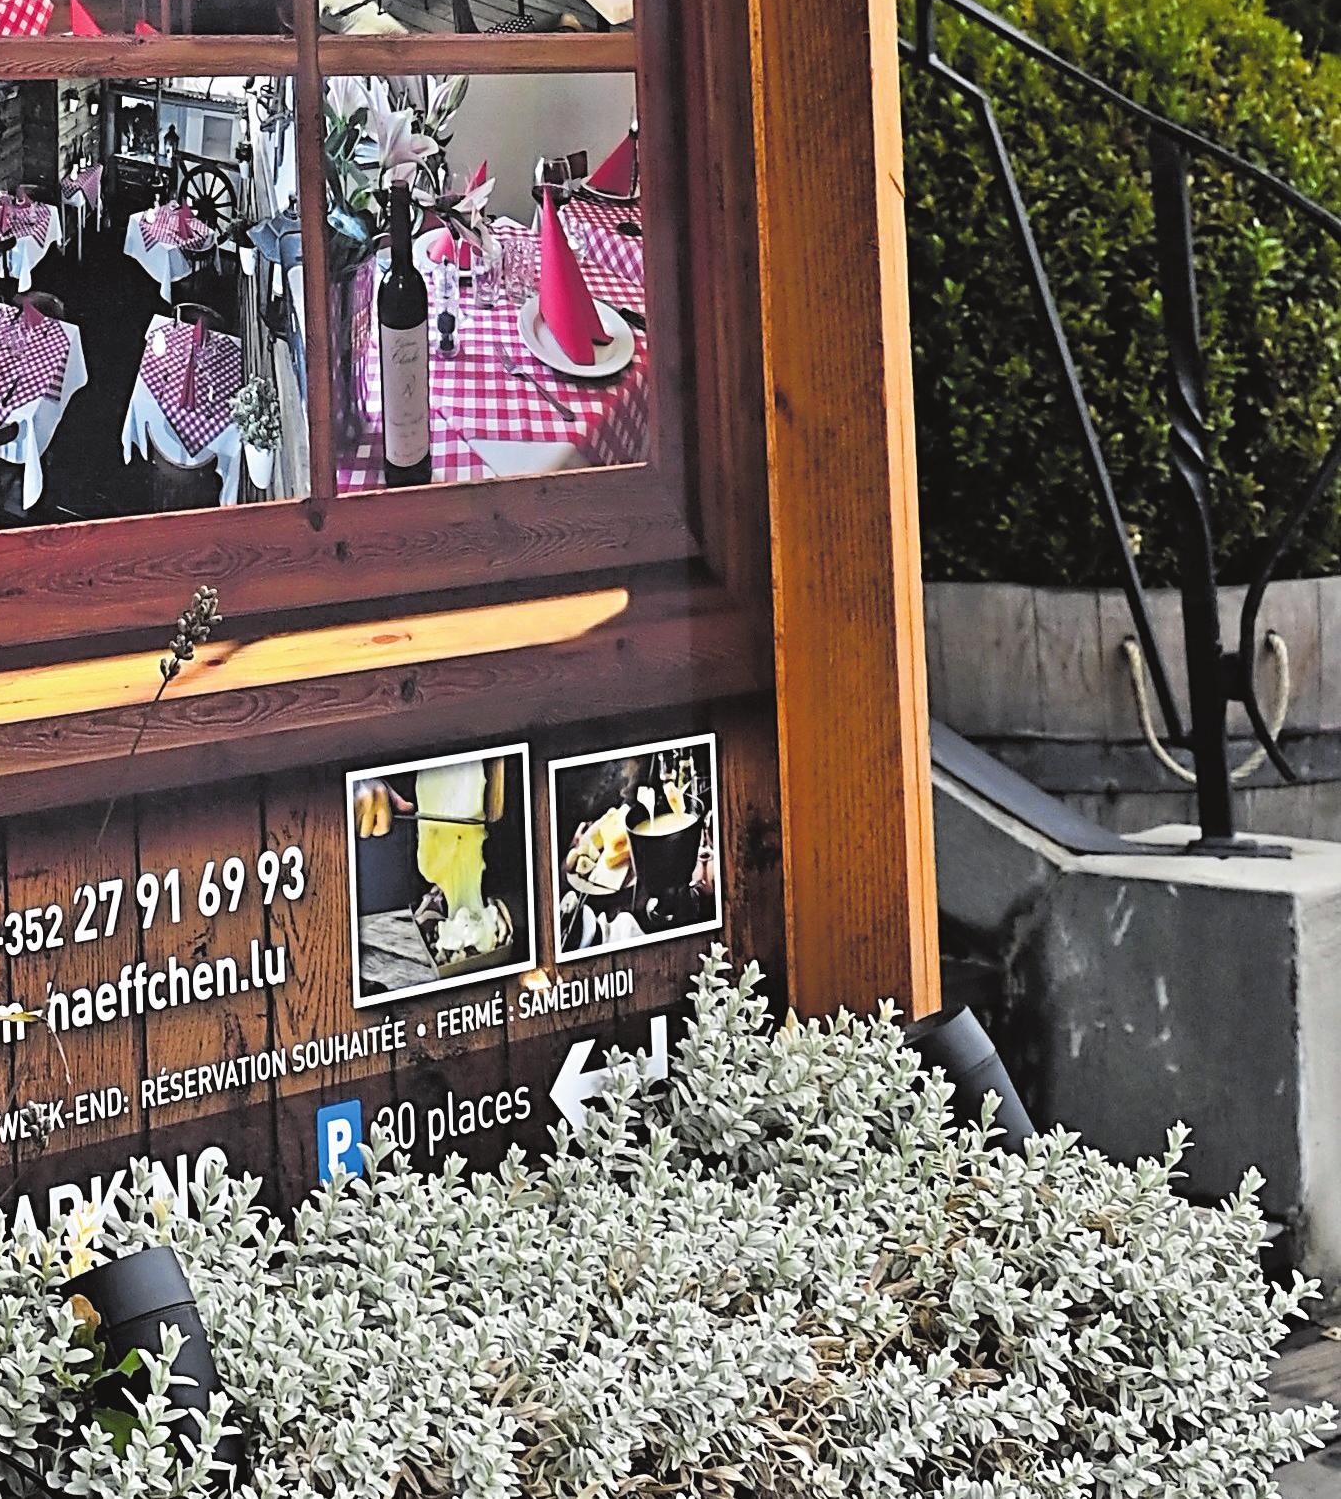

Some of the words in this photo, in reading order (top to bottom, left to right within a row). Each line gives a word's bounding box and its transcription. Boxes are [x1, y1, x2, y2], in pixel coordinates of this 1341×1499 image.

[74, 878, 124, 943] 27
[136, 873, 181, 930] 91
[198, 856, 246, 917] 69
[257, 846, 305, 905] 93
[141, 1048, 287, 1109] RÉSERVATION
[292, 1015, 407, 1073] SOUHAITÉE
[518, 979, 589, 1021] SAMEDI
[594, 968, 634, 1003] MIDI
[377, 1102, 416, 1151] 30
[427, 1085, 531, 1157] places
